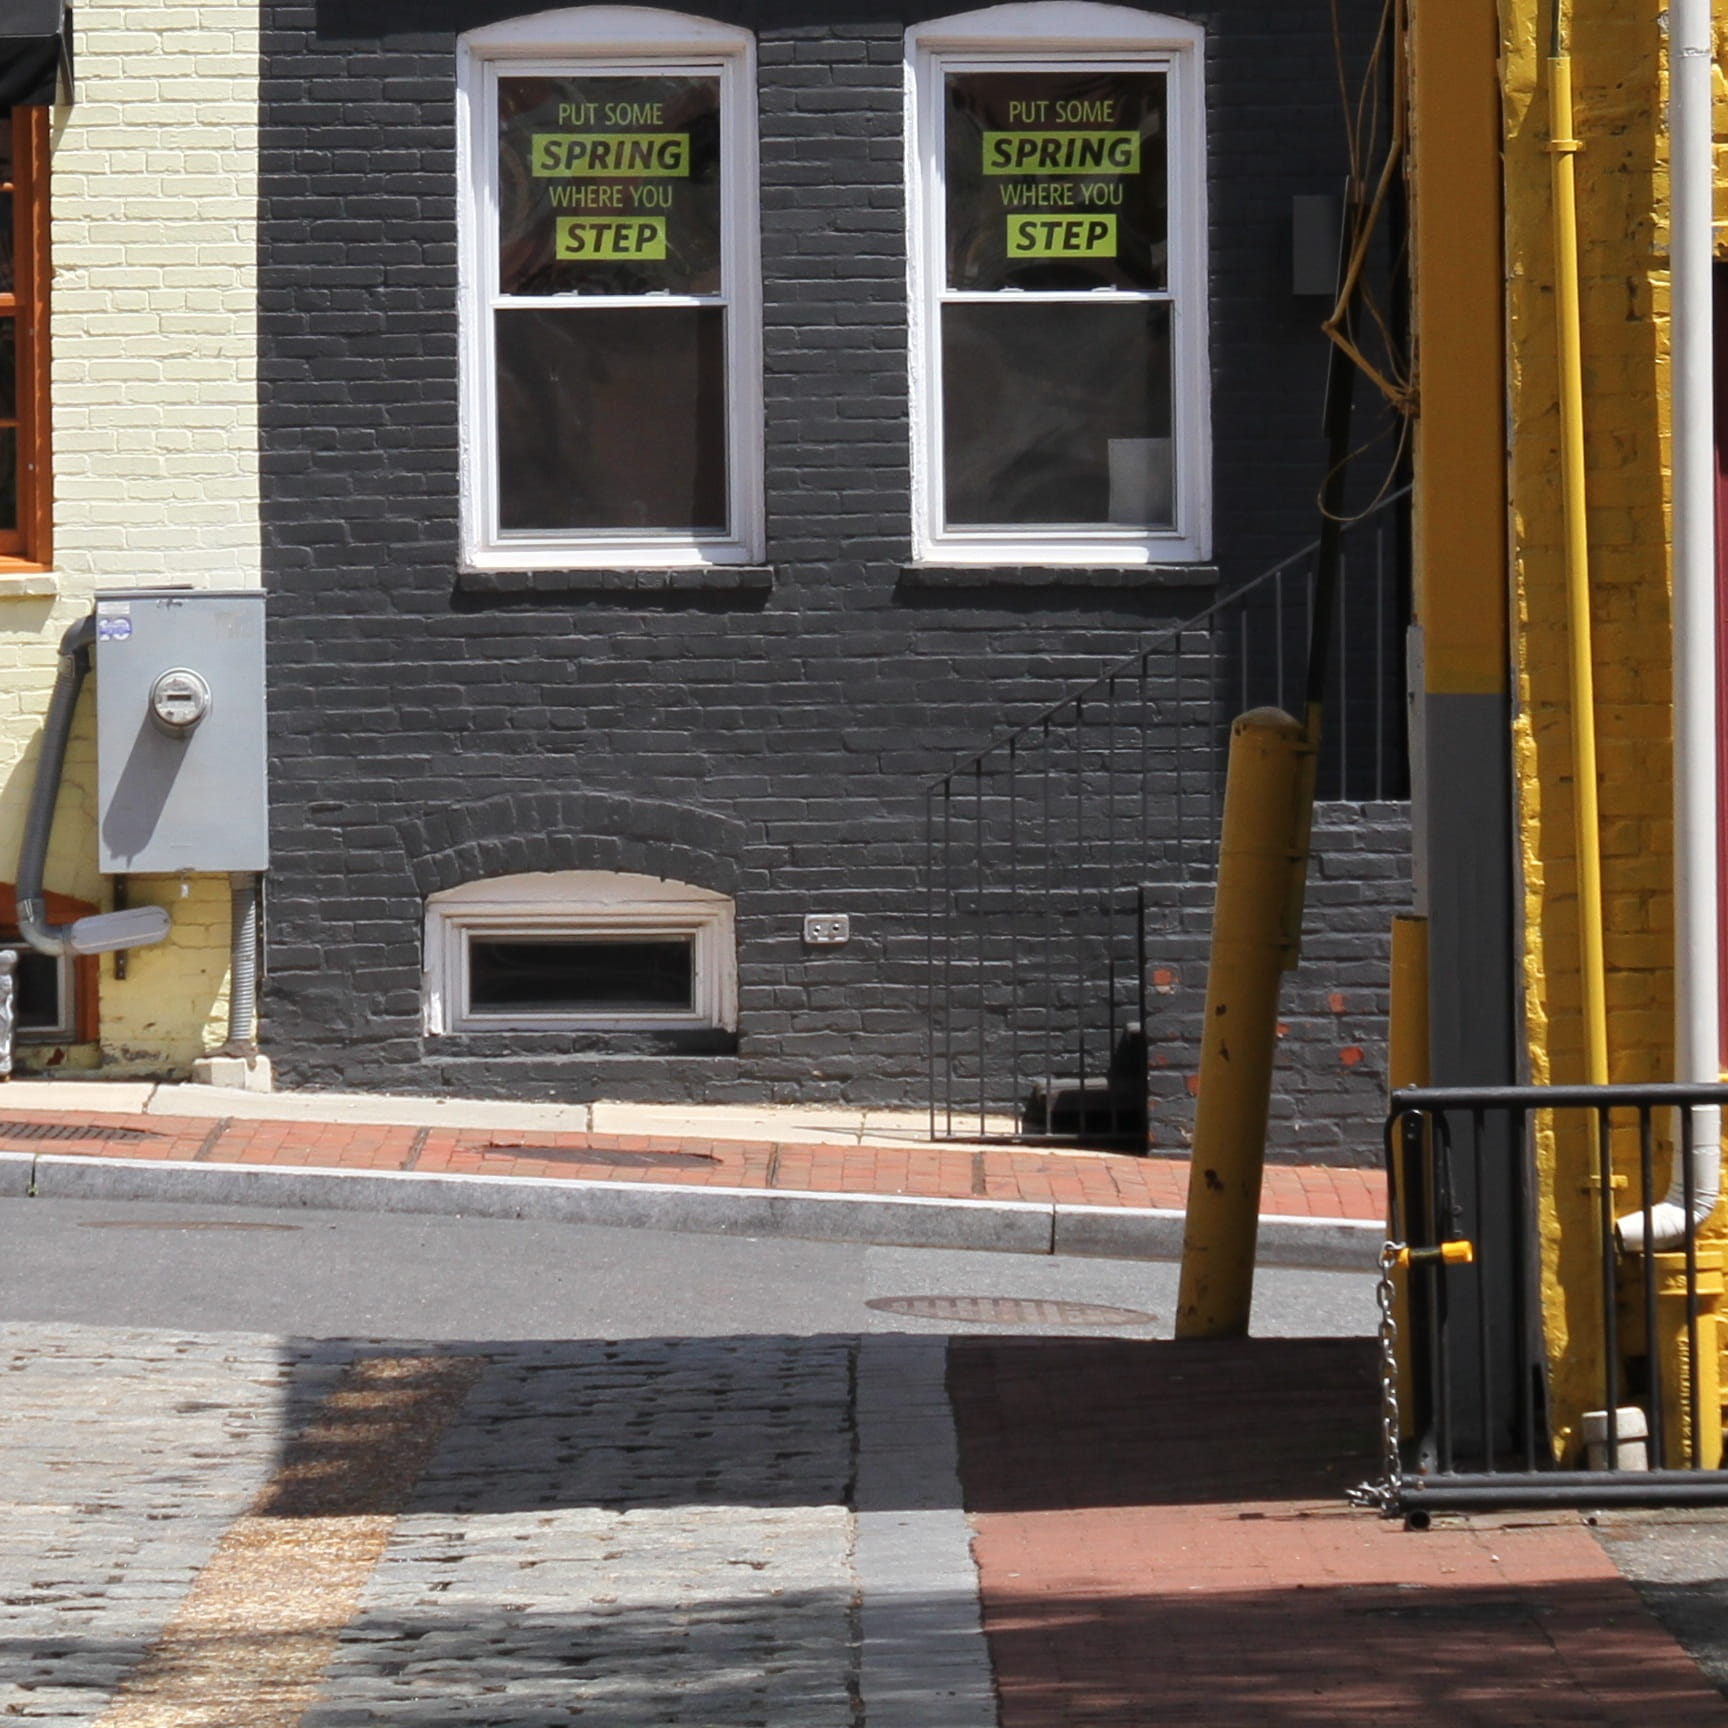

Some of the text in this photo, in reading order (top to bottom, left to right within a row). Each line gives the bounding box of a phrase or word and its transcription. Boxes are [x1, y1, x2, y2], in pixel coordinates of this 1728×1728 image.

[558, 102, 664, 126] PUT SOME
[1009, 100, 1115, 123] PUT SOME
[540, 139, 683, 171] SPRING
[990, 136, 1133, 169] SPRING
[549, 185, 673, 208] WHERE YOU
[1000, 183, 1123, 206] WHERE YOU
[565, 223, 658, 253] STEP
[1015, 221, 1109, 251] STEP
